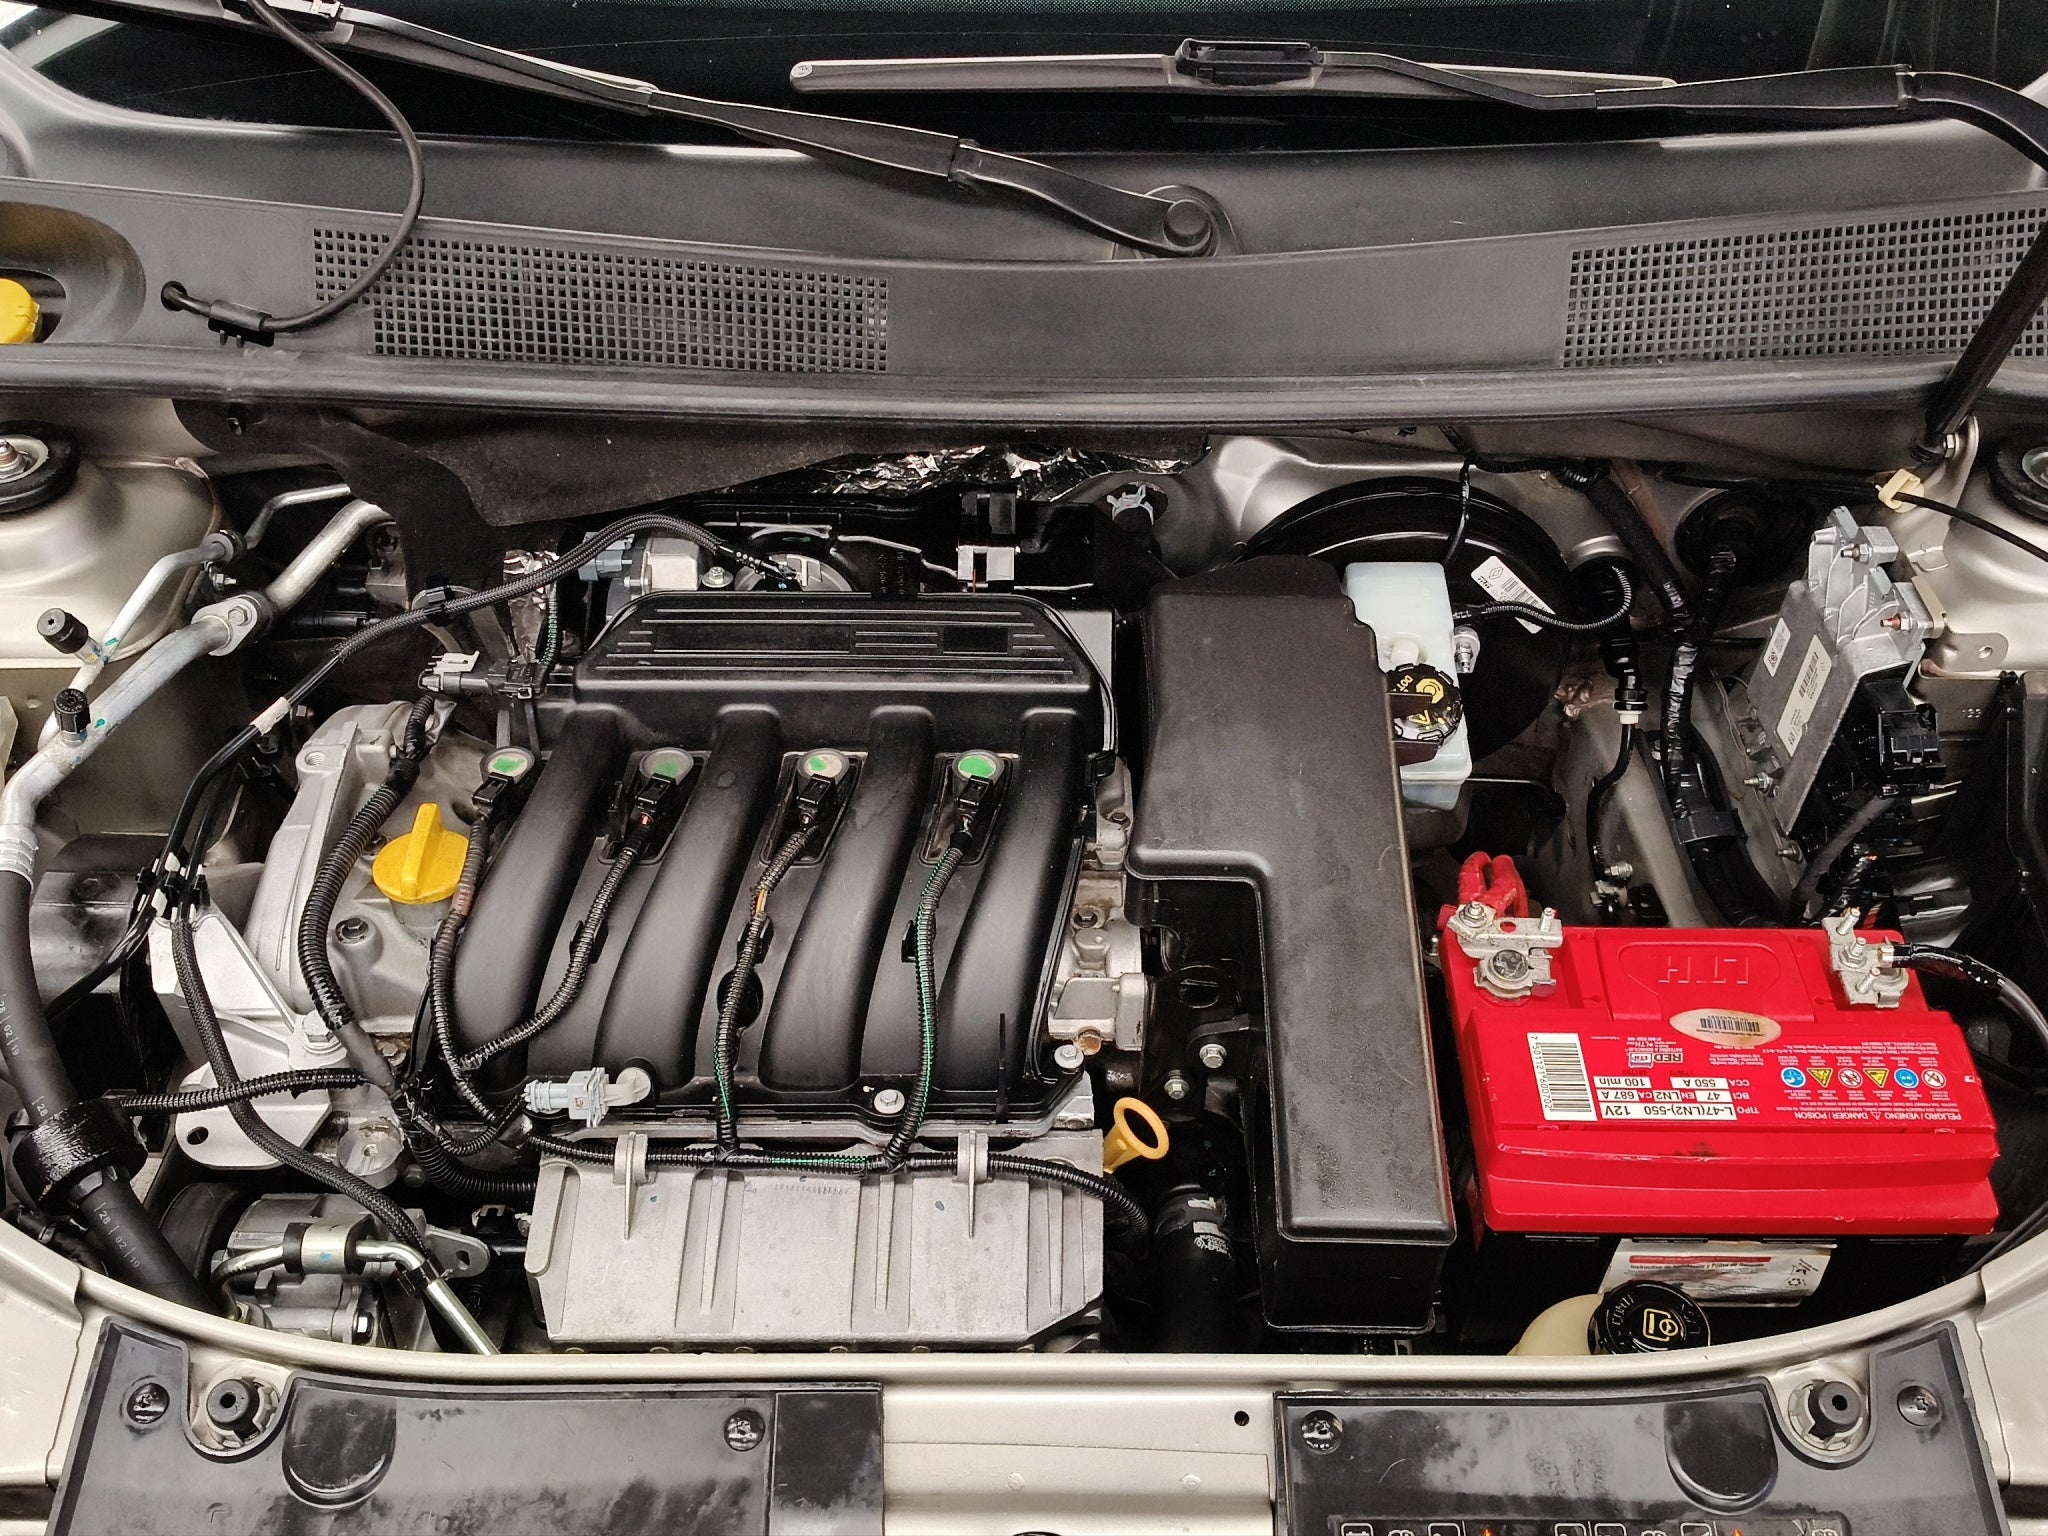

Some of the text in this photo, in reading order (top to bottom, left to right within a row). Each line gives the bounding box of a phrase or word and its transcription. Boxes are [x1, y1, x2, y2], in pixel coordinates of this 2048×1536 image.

[1396, 674, 1414, 692] DOT
[4, 1024, 13, 1038] 02
[1653, 1053, 1681, 1062] RED
[1599, 1077, 1750, 1087] CCA 550 A 100 min
[1601, 1091, 1750, 1100] BCI 47 EN LN2 CA 687 A
[1604, 1104, 1760, 1116] TIPO L-47(LN2)-550 12V
[1794, 1111, 1828, 1120] POISON
[1832, 1112, 1869, 1120] DANGER
[1884, 1112, 1920, 1120] VENENO
[1924, 1112, 1962, 1121] PELIGRO
[98, 1210, 141, 1268] 28 02 19
